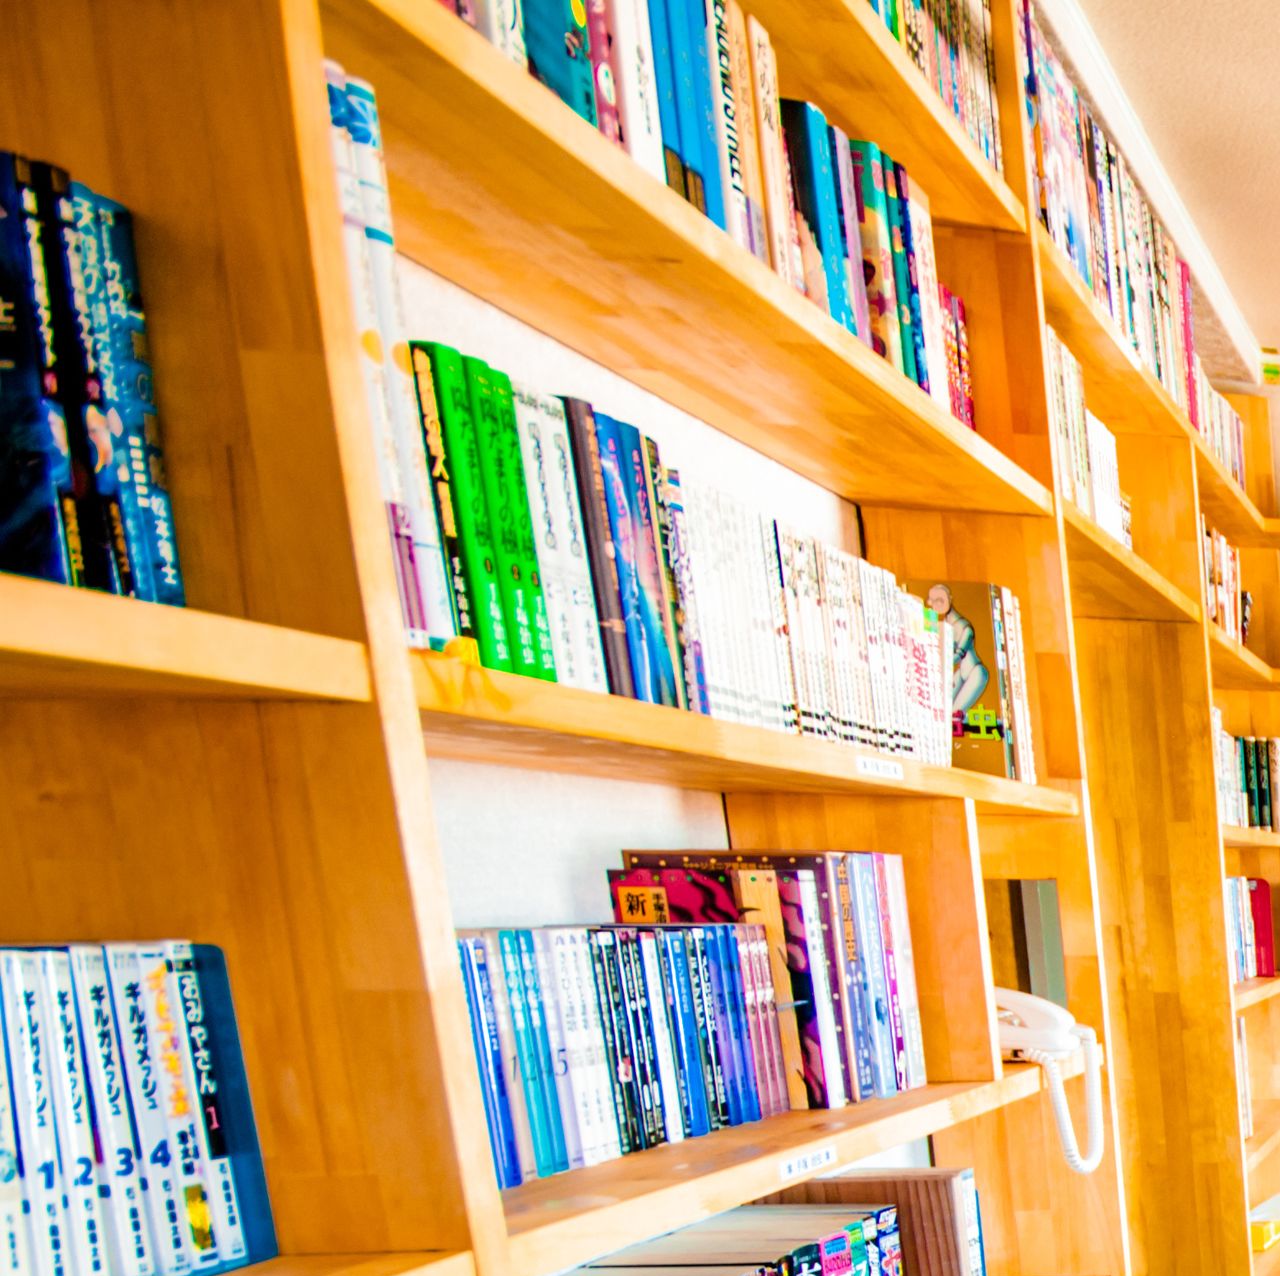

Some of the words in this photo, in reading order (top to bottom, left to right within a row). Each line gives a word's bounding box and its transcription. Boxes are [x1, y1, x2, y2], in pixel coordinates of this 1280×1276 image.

[968, 704, 1001, 742] 虫
[624, 892, 647, 917] 新
[206, 1106, 221, 1130] 1
[115, 1148, 135, 1177] 3
[150, 1140, 171, 1168] 4
[37, 1160, 56, 1190] 1
[74, 1157, 94, 1187] 2
